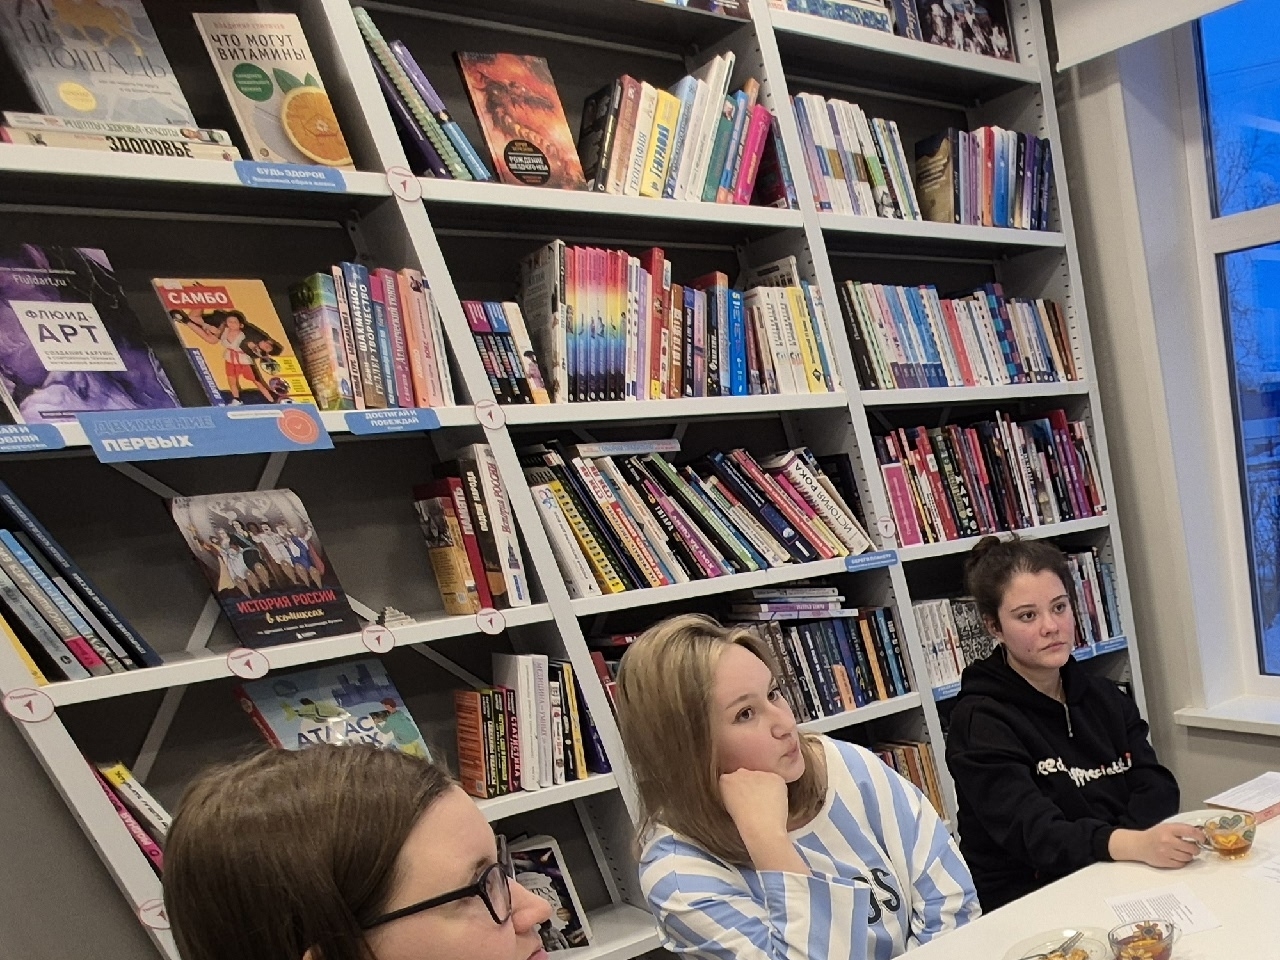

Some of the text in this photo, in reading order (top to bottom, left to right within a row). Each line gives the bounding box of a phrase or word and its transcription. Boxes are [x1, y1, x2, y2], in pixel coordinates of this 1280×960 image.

[211, 34, 293, 47] ЧТО МОГУТ
[219, 48, 307, 61] ВИТАМИНЫ
[106, 135, 194, 158] ЗДОРОВЬЕ
[628, 131, 648, 190] ГЕОГРАФИЯ
[257, 167, 325, 179] БУДЬ ЗДОРОВ
[13, 274, 67, 287] Fluidart.ru
[168, 291, 229, 305] САМБО
[25, 309, 93, 322] ФЛЮИД-
[348, 280, 367, 351] ШАХМАТНОЕ
[359, 283, 377, 353] ТВОРЧЕСТВО
[38, 323, 100, 344] АРТ
[365, 410, 410, 420] ДОСТИГАЙ
[370, 417, 419, 427] ПОБЕЖДАЙ
[94, 415, 216, 435] ДВИЖЕНИЕ
[101, 435, 194, 452] ПЕРВЫХ
[793, 461, 852, 534] ИСТОРИЯ РОКА
[236, 590, 337, 614] ИСТОРИЯ РОССИИ
[509, 716, 521, 776] СТАТИСТИКА
